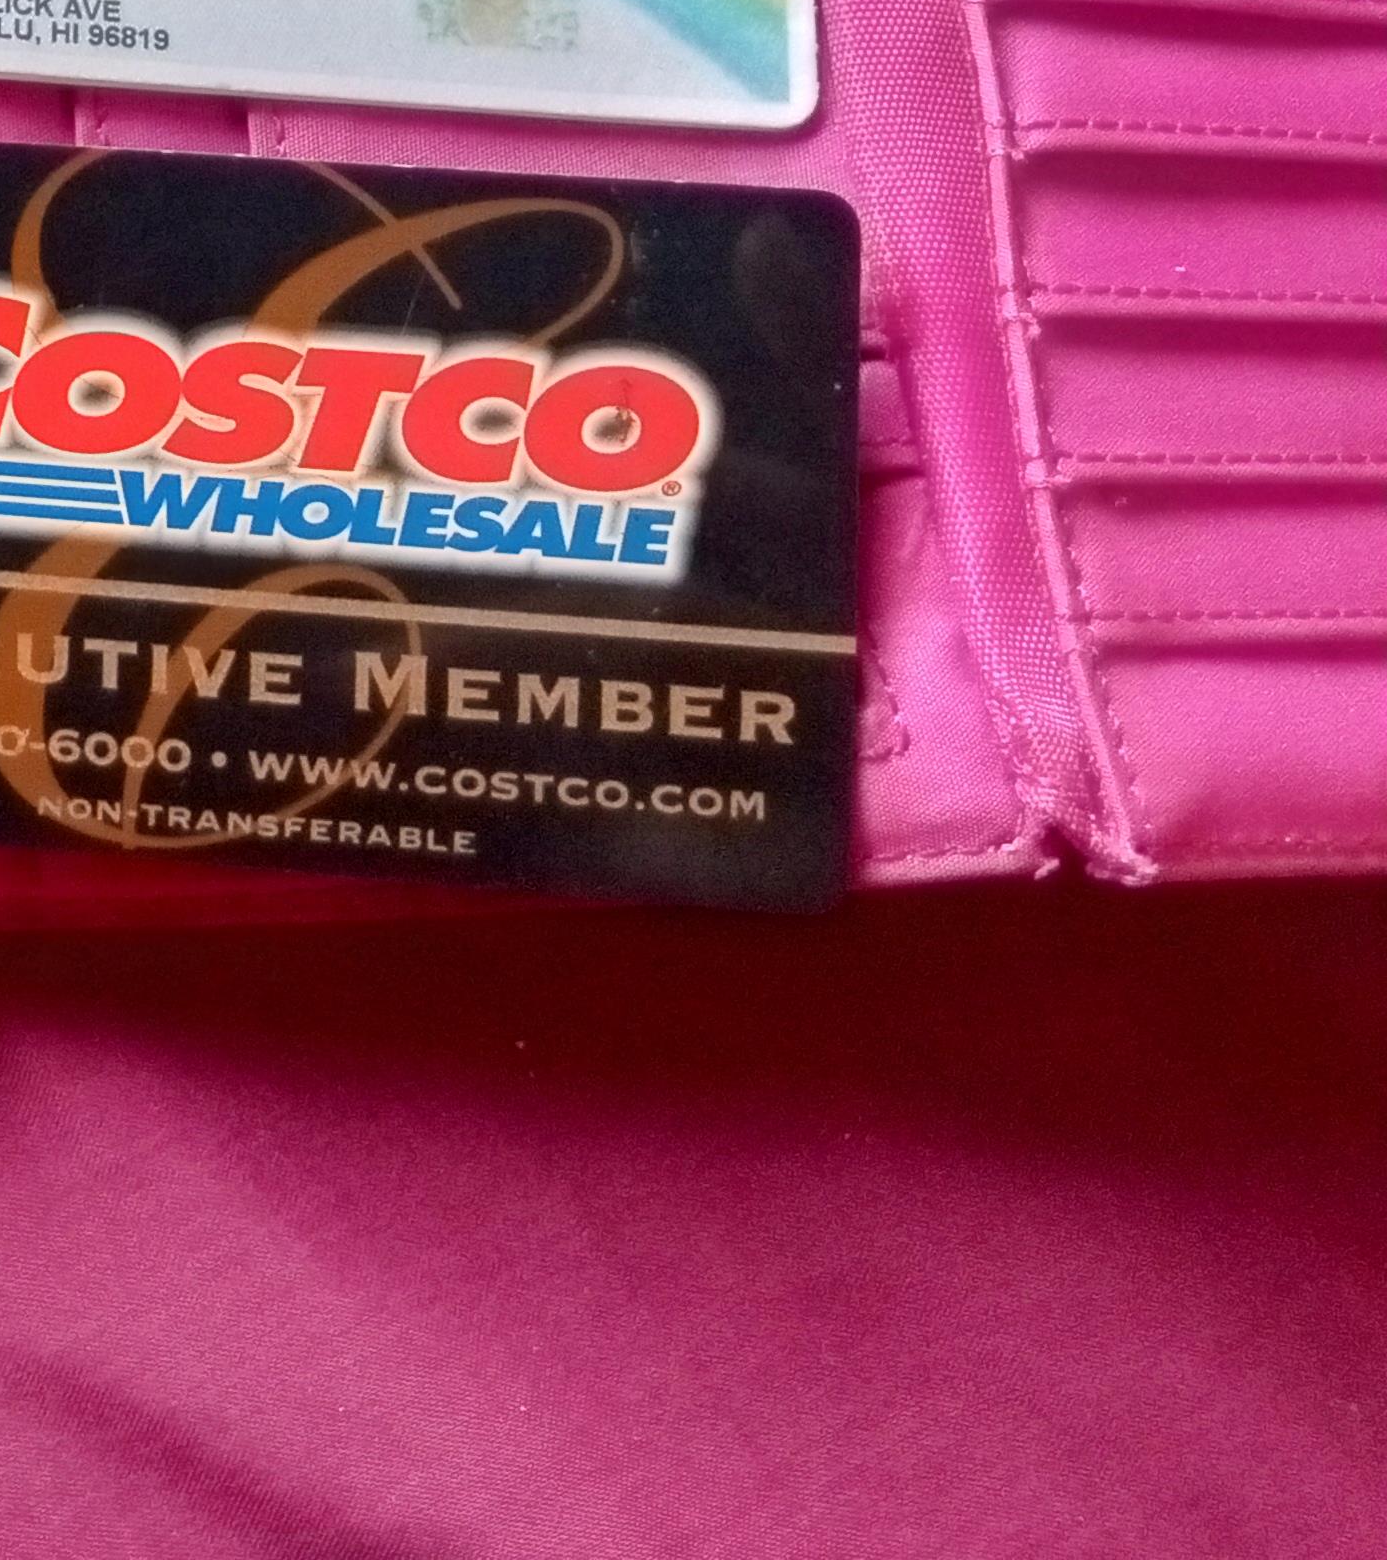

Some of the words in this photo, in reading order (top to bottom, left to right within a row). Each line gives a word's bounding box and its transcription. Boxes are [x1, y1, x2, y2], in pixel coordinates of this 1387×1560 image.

[51, 21, 79, 45] HI
[88, 25, 170, 51] 96819
[118, 468, 676, 566] WHOLESALE
[353, 651, 797, 746] MEMBER
[248, 748, 766, 821] WWW.COSTCO.COM
[38, 797, 476, 855] NON-TRANSFERABLE
